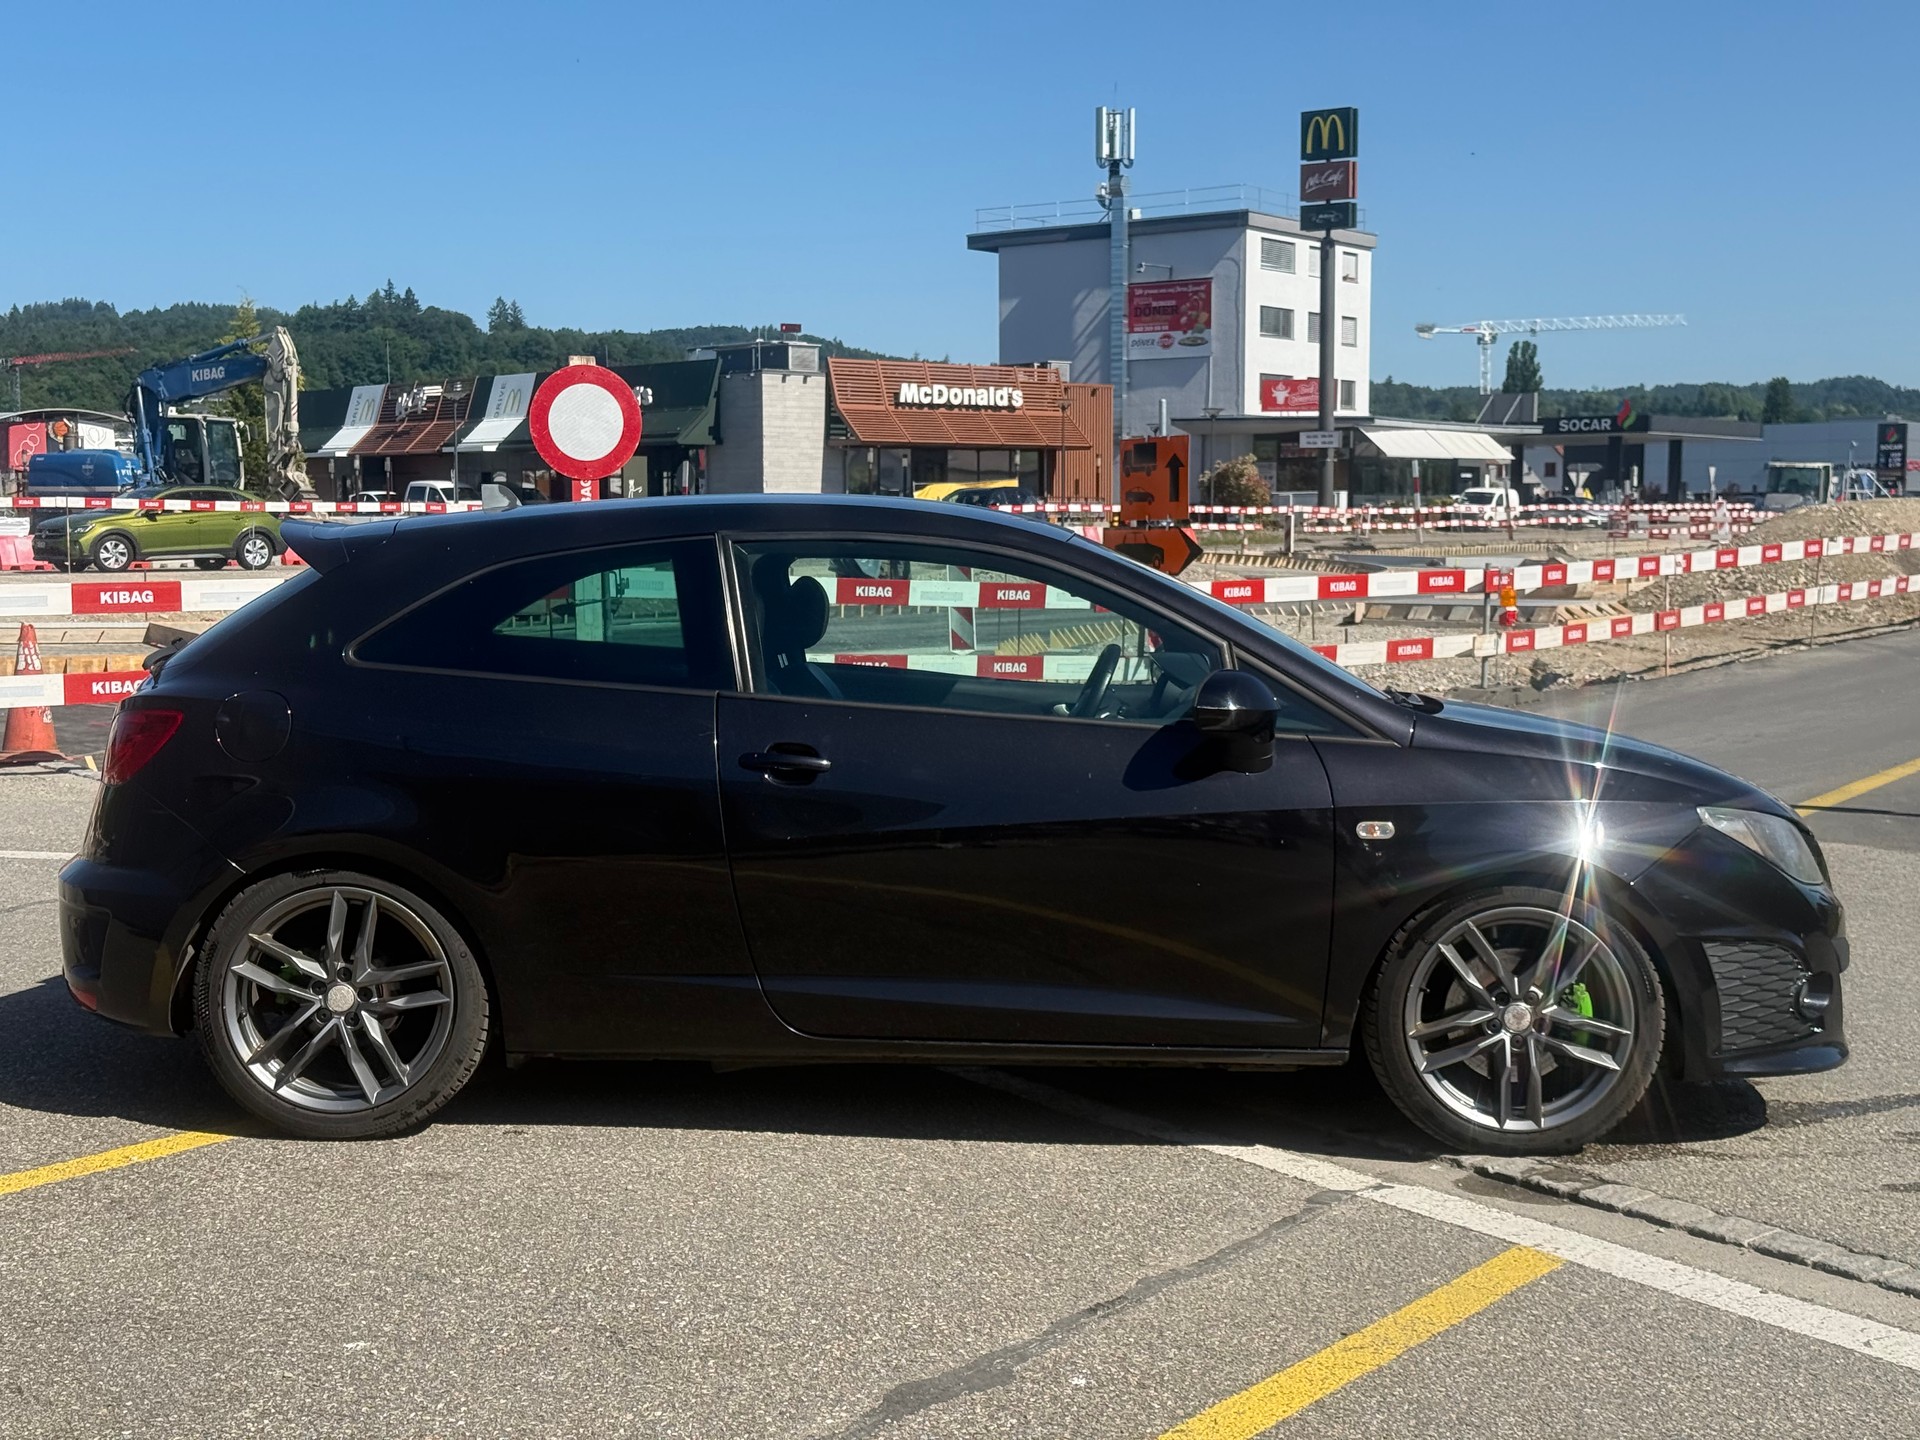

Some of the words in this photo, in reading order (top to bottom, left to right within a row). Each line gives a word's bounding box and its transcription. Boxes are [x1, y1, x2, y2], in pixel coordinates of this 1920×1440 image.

[192, 366, 226, 382] KIBAG
[899, 382, 1024, 407] McDonald's
[1558, 418, 1611, 431] SOCAR
[1330, 581, 1356, 592] KIBAG
[1429, 575, 1454, 587] KIBAG
[100, 590, 154, 604] KIBAG
[856, 586, 892, 598] KIBAG
[997, 589, 1031, 601] KIBAG
[1224, 586, 1251, 597] KIBAG
[1398, 644, 1423, 655] KIBAG
[994, 662, 1027, 673] KIBAG
